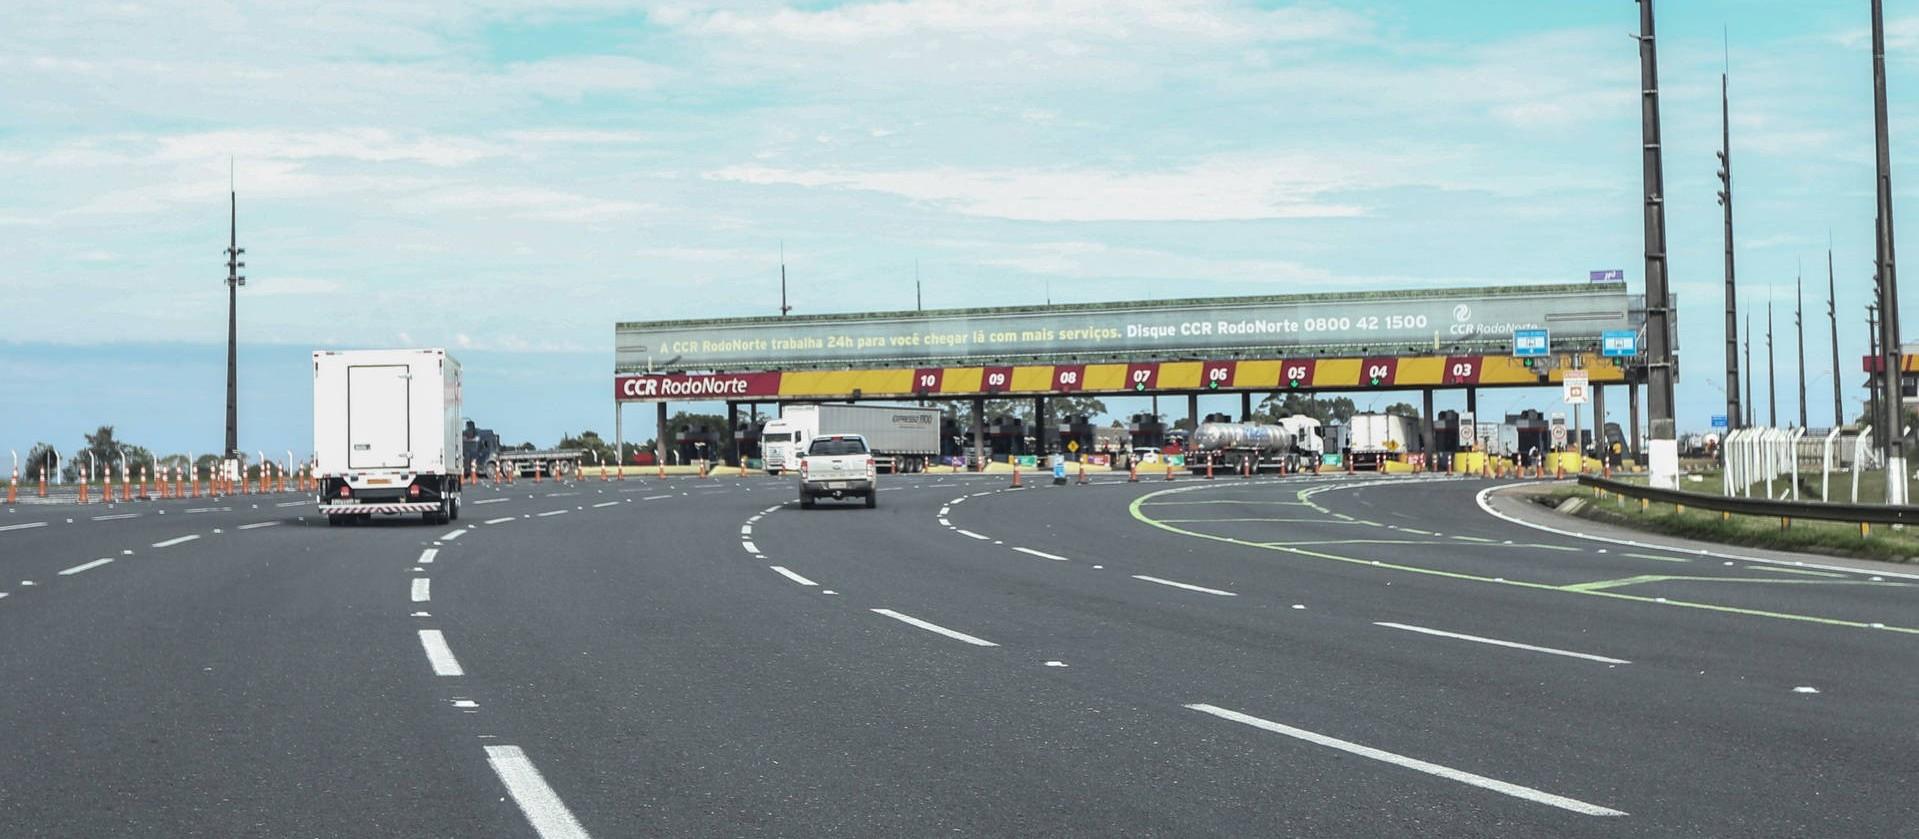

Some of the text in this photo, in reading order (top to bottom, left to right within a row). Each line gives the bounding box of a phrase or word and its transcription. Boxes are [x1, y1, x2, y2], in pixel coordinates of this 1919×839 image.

[660, 315, 1427, 353] A CCR RodoNorte trabalha 24h para você chegar lá com mais serviços. Disque CCR RodoNorte 0800 42 1500
[1450, 323, 1474, 335] CCR
[1133, 370, 1151, 382] 07
[1209, 368, 1228, 380] 06
[1287, 367, 1306, 379] 05
[1369, 365, 1387, 378] 04
[1453, 363, 1472, 376] 03
[920, 374, 936, 387] 10
[988, 373, 1005, 385] 09
[1059, 371, 1077, 384] 08
[623, 377, 748, 396] CCR RodoNorte
